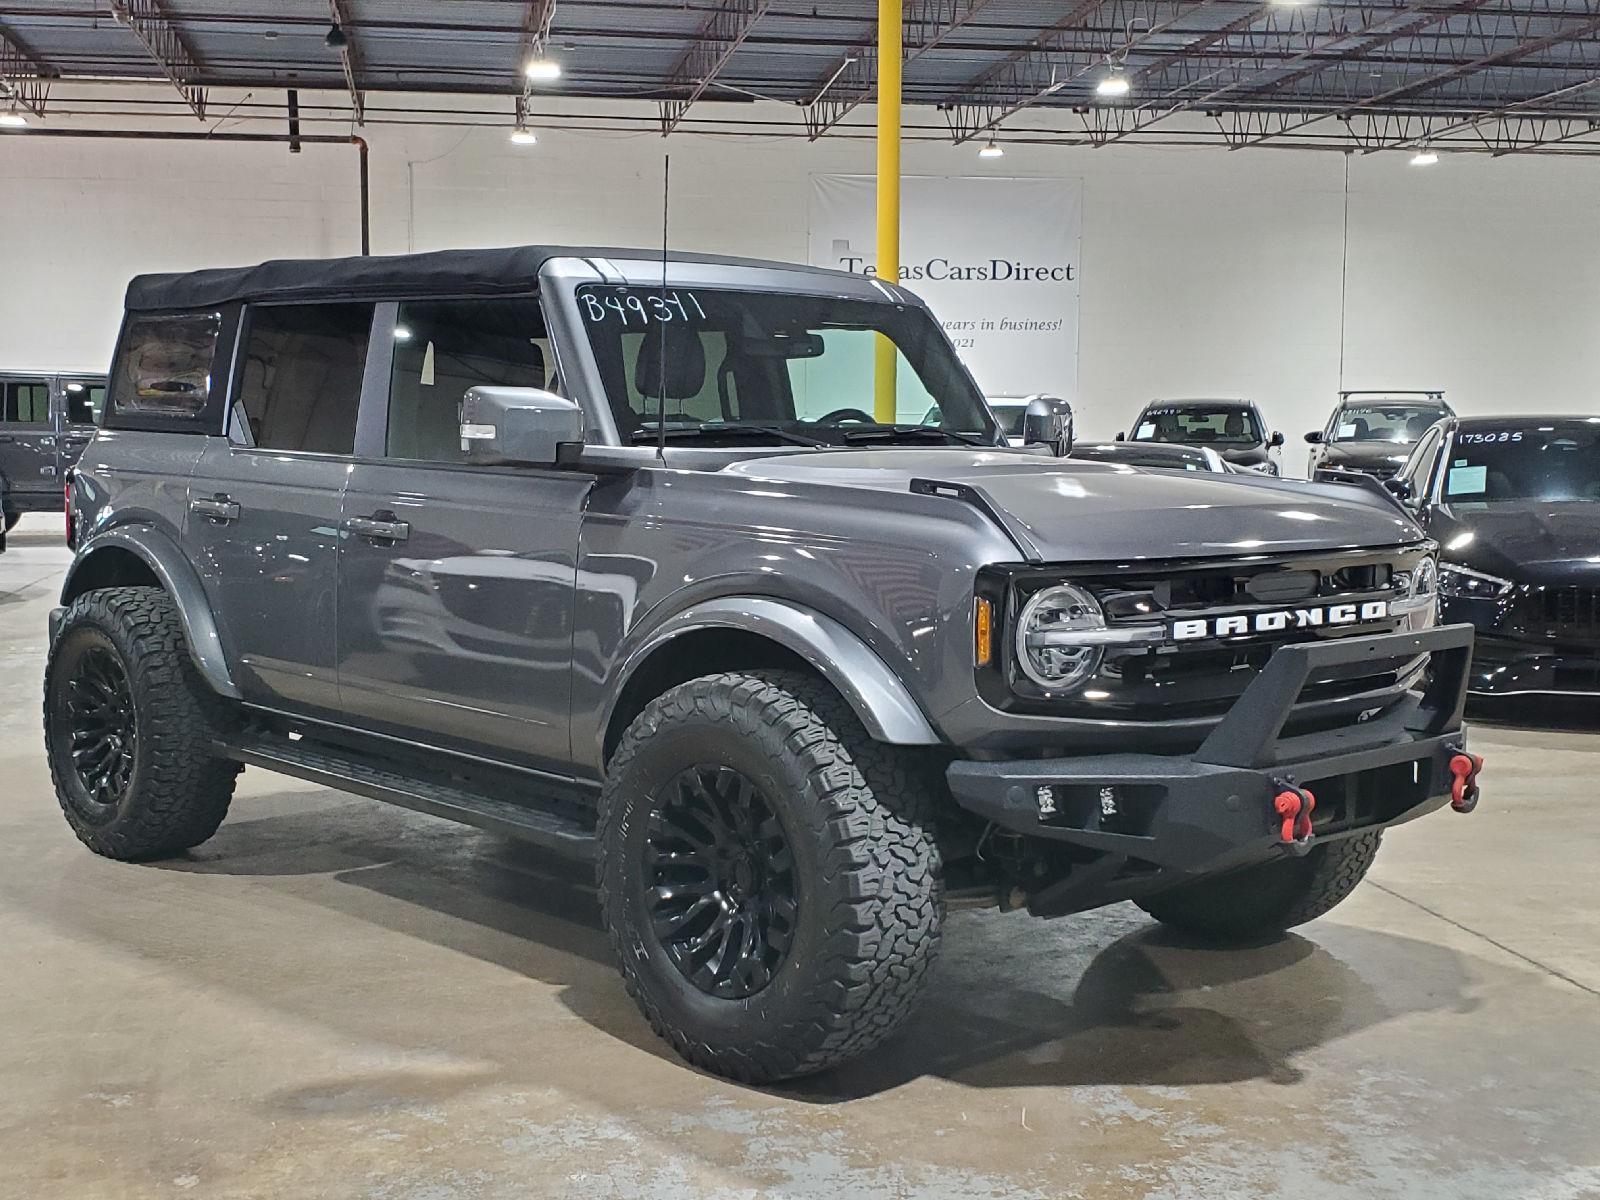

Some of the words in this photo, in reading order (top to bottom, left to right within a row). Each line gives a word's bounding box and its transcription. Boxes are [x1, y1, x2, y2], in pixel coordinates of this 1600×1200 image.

[840, 257, 1075, 281] TeasCarsDirect
[981, 317, 995, 331] in
[999, 316, 1063, 331] business!
[952, 338, 975, 348] 021
[1459, 431, 1523, 445] 173085
[1173, 601, 1387, 640] BRONCO
